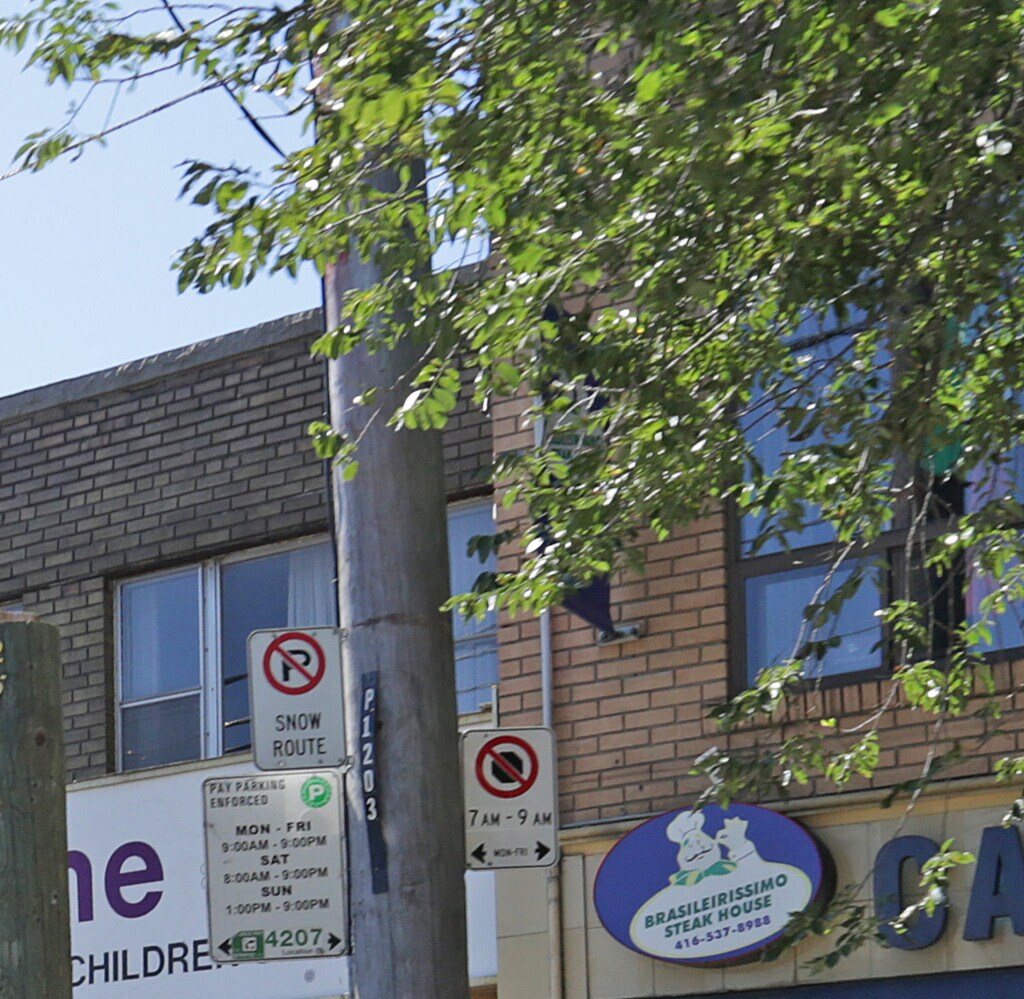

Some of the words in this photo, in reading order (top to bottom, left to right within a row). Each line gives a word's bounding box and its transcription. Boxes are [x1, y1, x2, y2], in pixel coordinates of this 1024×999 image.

[276, 712, 321, 732] SNOW
[273, 738, 326, 758] ROUTE
[209, 783, 231, 794] PAY
[236, 780, 286, 792] PARKING
[210, 795, 269, 808] ENFORCED
[236, 824, 271, 836] MON
[286, 821, 312, 833] FRI
[221, 840, 269, 853] 9:00AM
[280, 836, 327, 849] 9:00PM
[260, 854, 290, 866] SAT
[223, 871, 270, 884] 8:00AM
[281, 867, 328, 880] 9:00PM
[260, 885, 292, 897] SUN
[225, 903, 272, 915] 1:00PM
[282, 899, 329, 912] 9:00PM
[644, 873, 788, 929] BRASILEIRISSIMO
[665, 912, 713, 938] STEAK
[718, 895, 772, 922] HOUSE
[264, 929, 323, 948] 4207
[674, 914, 772, 950] 416-537-8988
